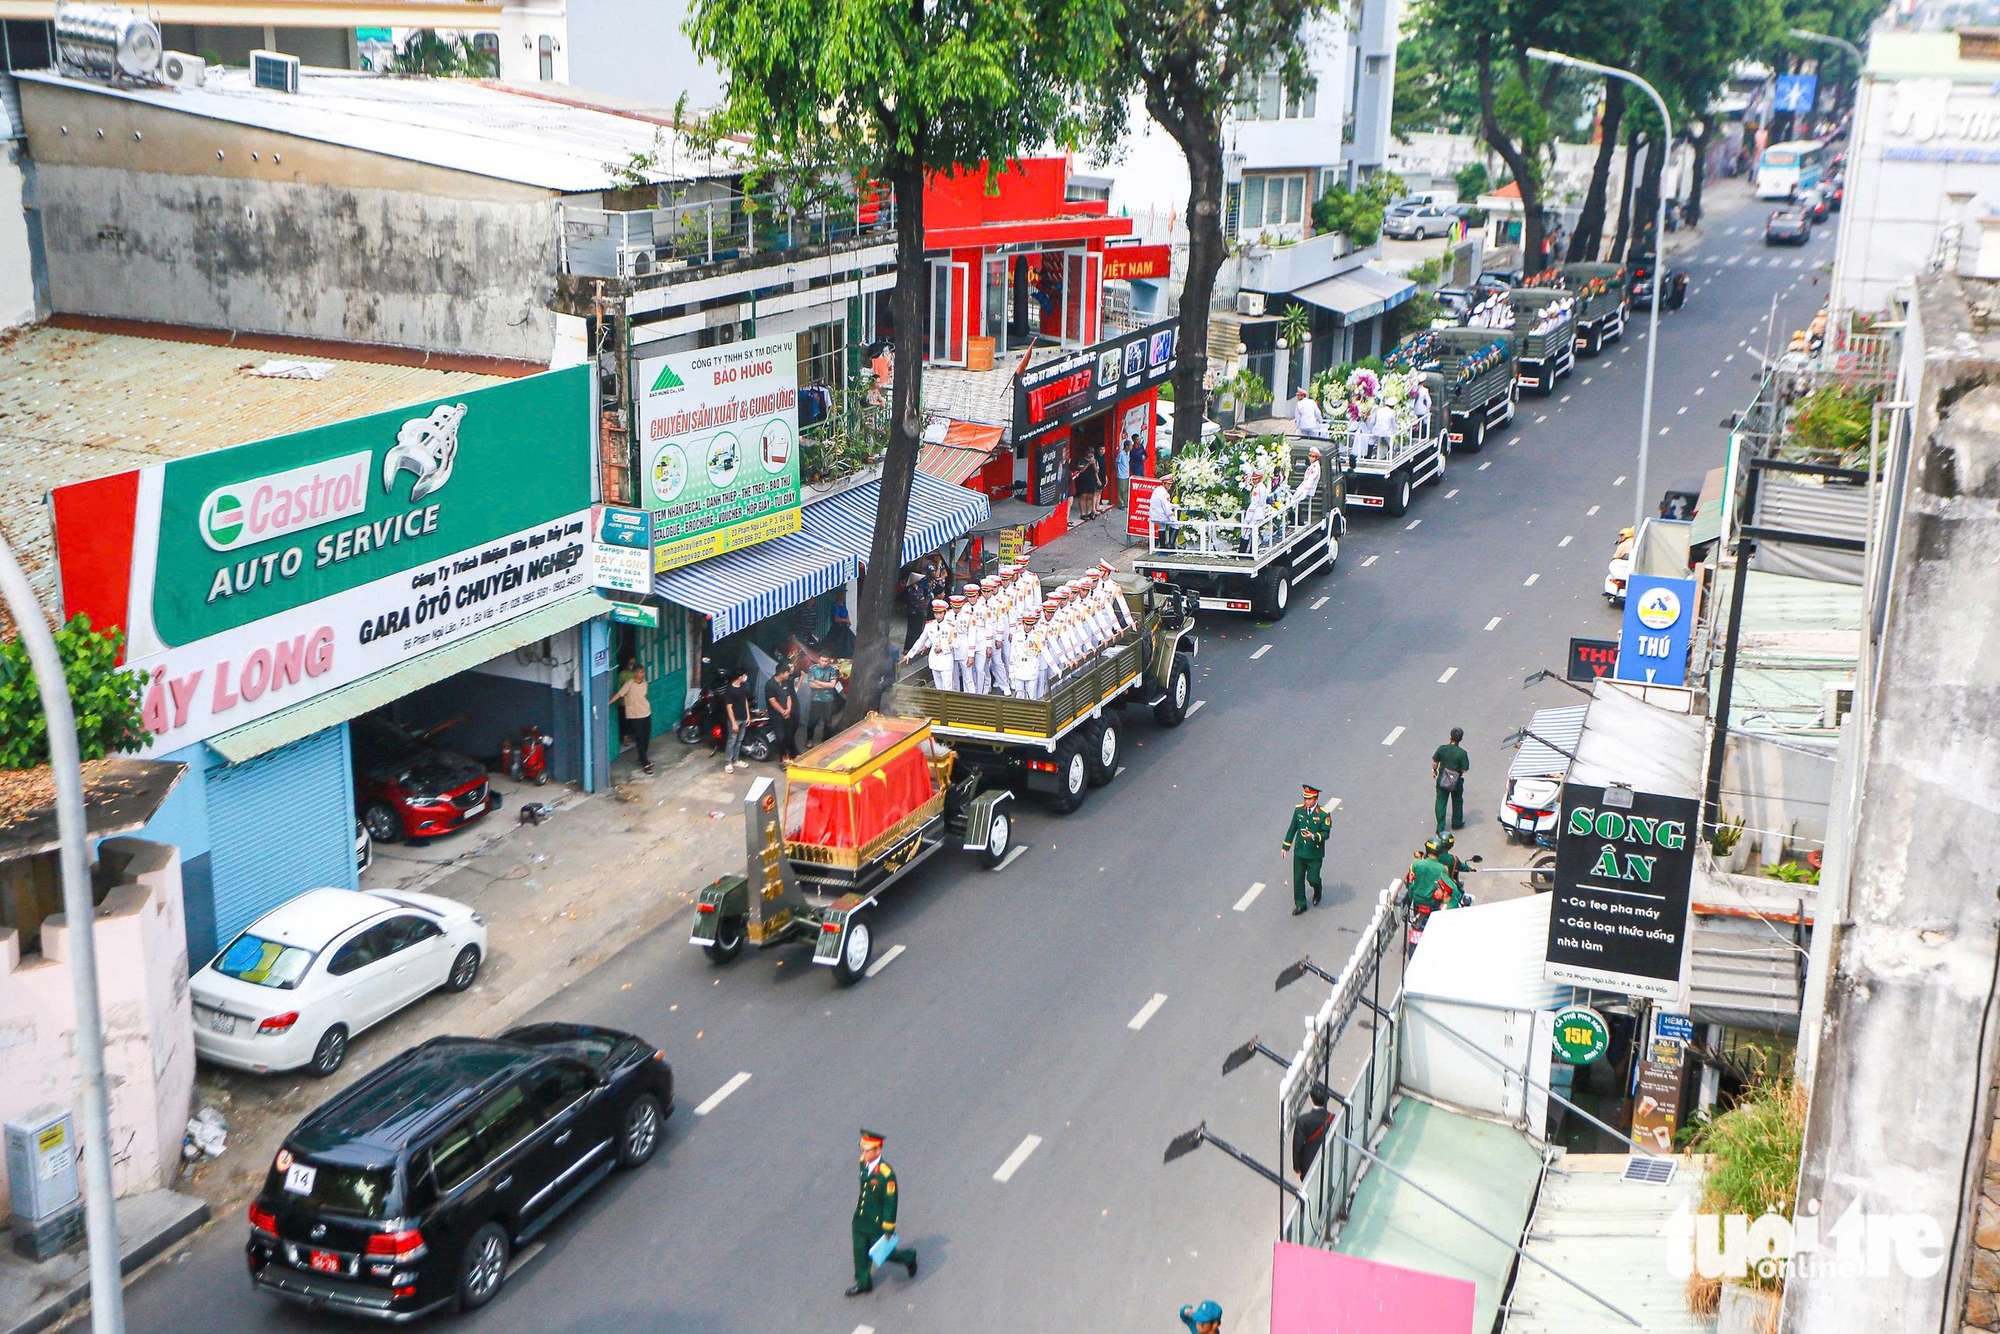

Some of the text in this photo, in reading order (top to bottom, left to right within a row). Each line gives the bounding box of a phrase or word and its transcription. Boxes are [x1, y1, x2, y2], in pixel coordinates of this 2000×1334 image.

[1128, 261, 1153, 276] NAM
[691, 357, 712, 370] CÔNG
[714, 355, 723, 364] TY
[724, 353, 743, 364] TNHH
[744, 351, 754, 360] SX
[755, 348, 765, 358] TM
[783, 342, 793, 352] VỤ
[713, 360, 773, 386] BẢO HÙNG
[650, 386, 796, 441] CHUYÊN SẢN XUẤT & CUNG ỨNG
[1132, 482, 1157, 490] WINNE
[249, 462, 363, 535] Castrol
[654, 510, 666, 522] TEM
[667, 506, 683, 518] NHÃN
[684, 501, 701, 514] DECAL
[706, 496, 721, 508] DANH
[722, 489, 737, 504] THIẾP
[752, 482, 765, 496] TREO
[770, 479, 780, 490] BAO
[654, 525, 680, 540] ATALOGUE
[685, 515, 714, 533] BROCHURE
[718, 507, 742, 523] VOUCHER
[731, 529, 738, 537] 23
[205, 504, 441, 605] AUTO SERVICE
[412, 570, 436, 590] Công
[438, 565, 450, 581] Ty
[452, 554, 478, 575] Trách
[564, 521, 584, 539] Long
[599, 545, 625, 555] Garage
[620, 559, 648, 570] LONG
[624, 568, 641, 576] 24/24
[359, 541, 584, 645] GARA ÔTÔ CHUYÊN NGHIỆP
[403, 638, 412, 650] 66
[1578, 646, 1618, 665] THÚ
[1638, 634, 1671, 659] THÚ
[212, 626, 336, 714] LONG
[1592, 665, 1608, 677] Y
[1645, 669, 1657, 683] Y
[1568, 806, 1686, 850] SONG
[1590, 844, 1657, 883] ÂN
[1570, 897, 1660, 920] Co fee pha máy
[1567, 916, 1675, 943] Các loại thức uống
[1557, 936, 1604, 952] nhà làm
[1555, 1018, 1564, 1028] CÀ
[1563, 1012, 1577, 1022] PHÊ
[1577, 1012, 1591, 1023] PHA
[1563, 1026, 1593, 1046] 15K
[293, 1170, 310, 1188] 14
